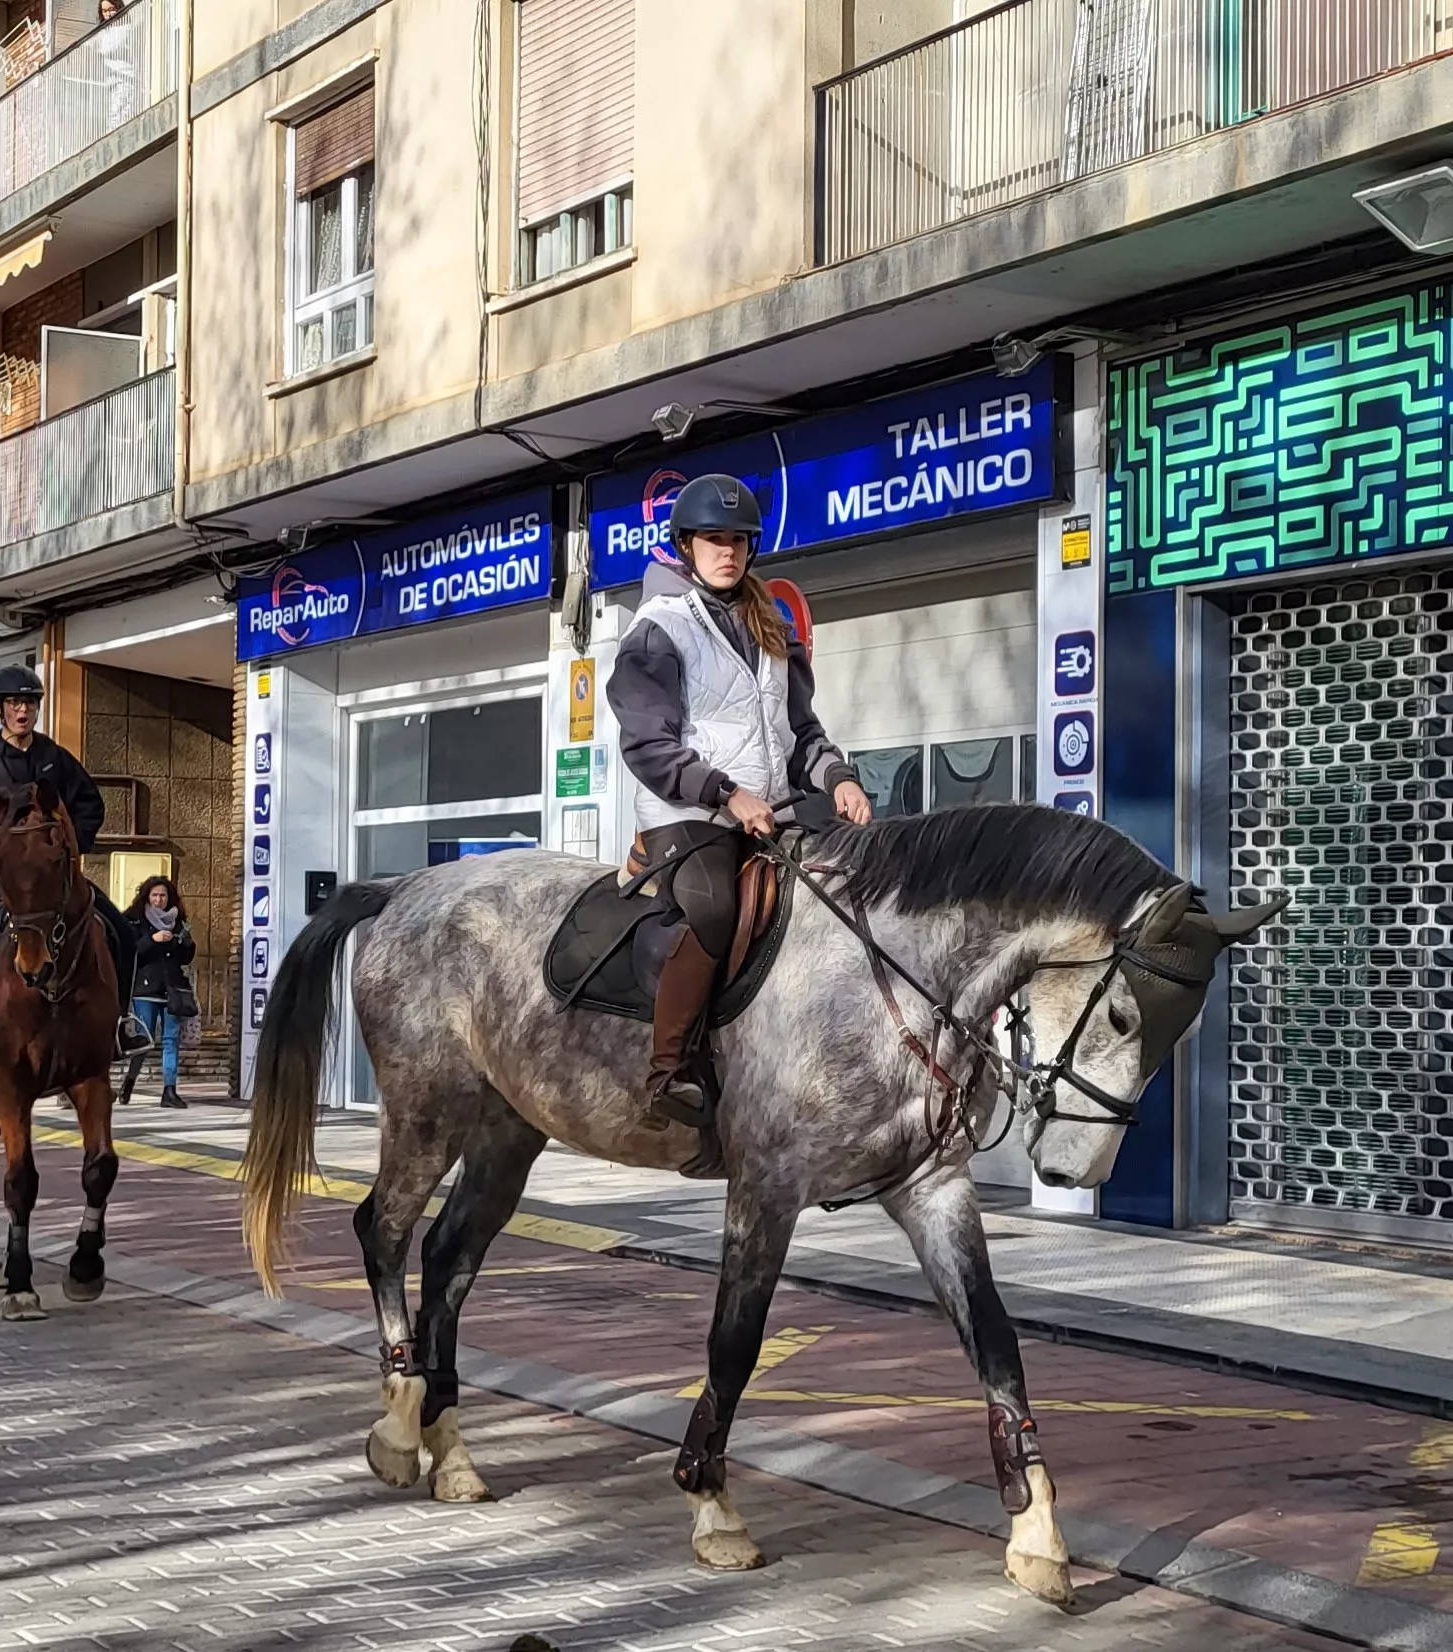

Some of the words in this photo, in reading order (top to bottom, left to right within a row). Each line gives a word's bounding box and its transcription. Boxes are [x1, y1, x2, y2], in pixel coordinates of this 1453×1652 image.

[887, 392, 1032, 459] TALLER
[827, 448, 1033, 525] MECÁNICO
[380, 512, 541, 581] AUTOMÓVILES
[607, 519, 670, 556] Repa
[249, 593, 349, 635] ReparAuto
[399, 581, 428, 614] DE
[432, 554, 540, 606] OCASIÓN
